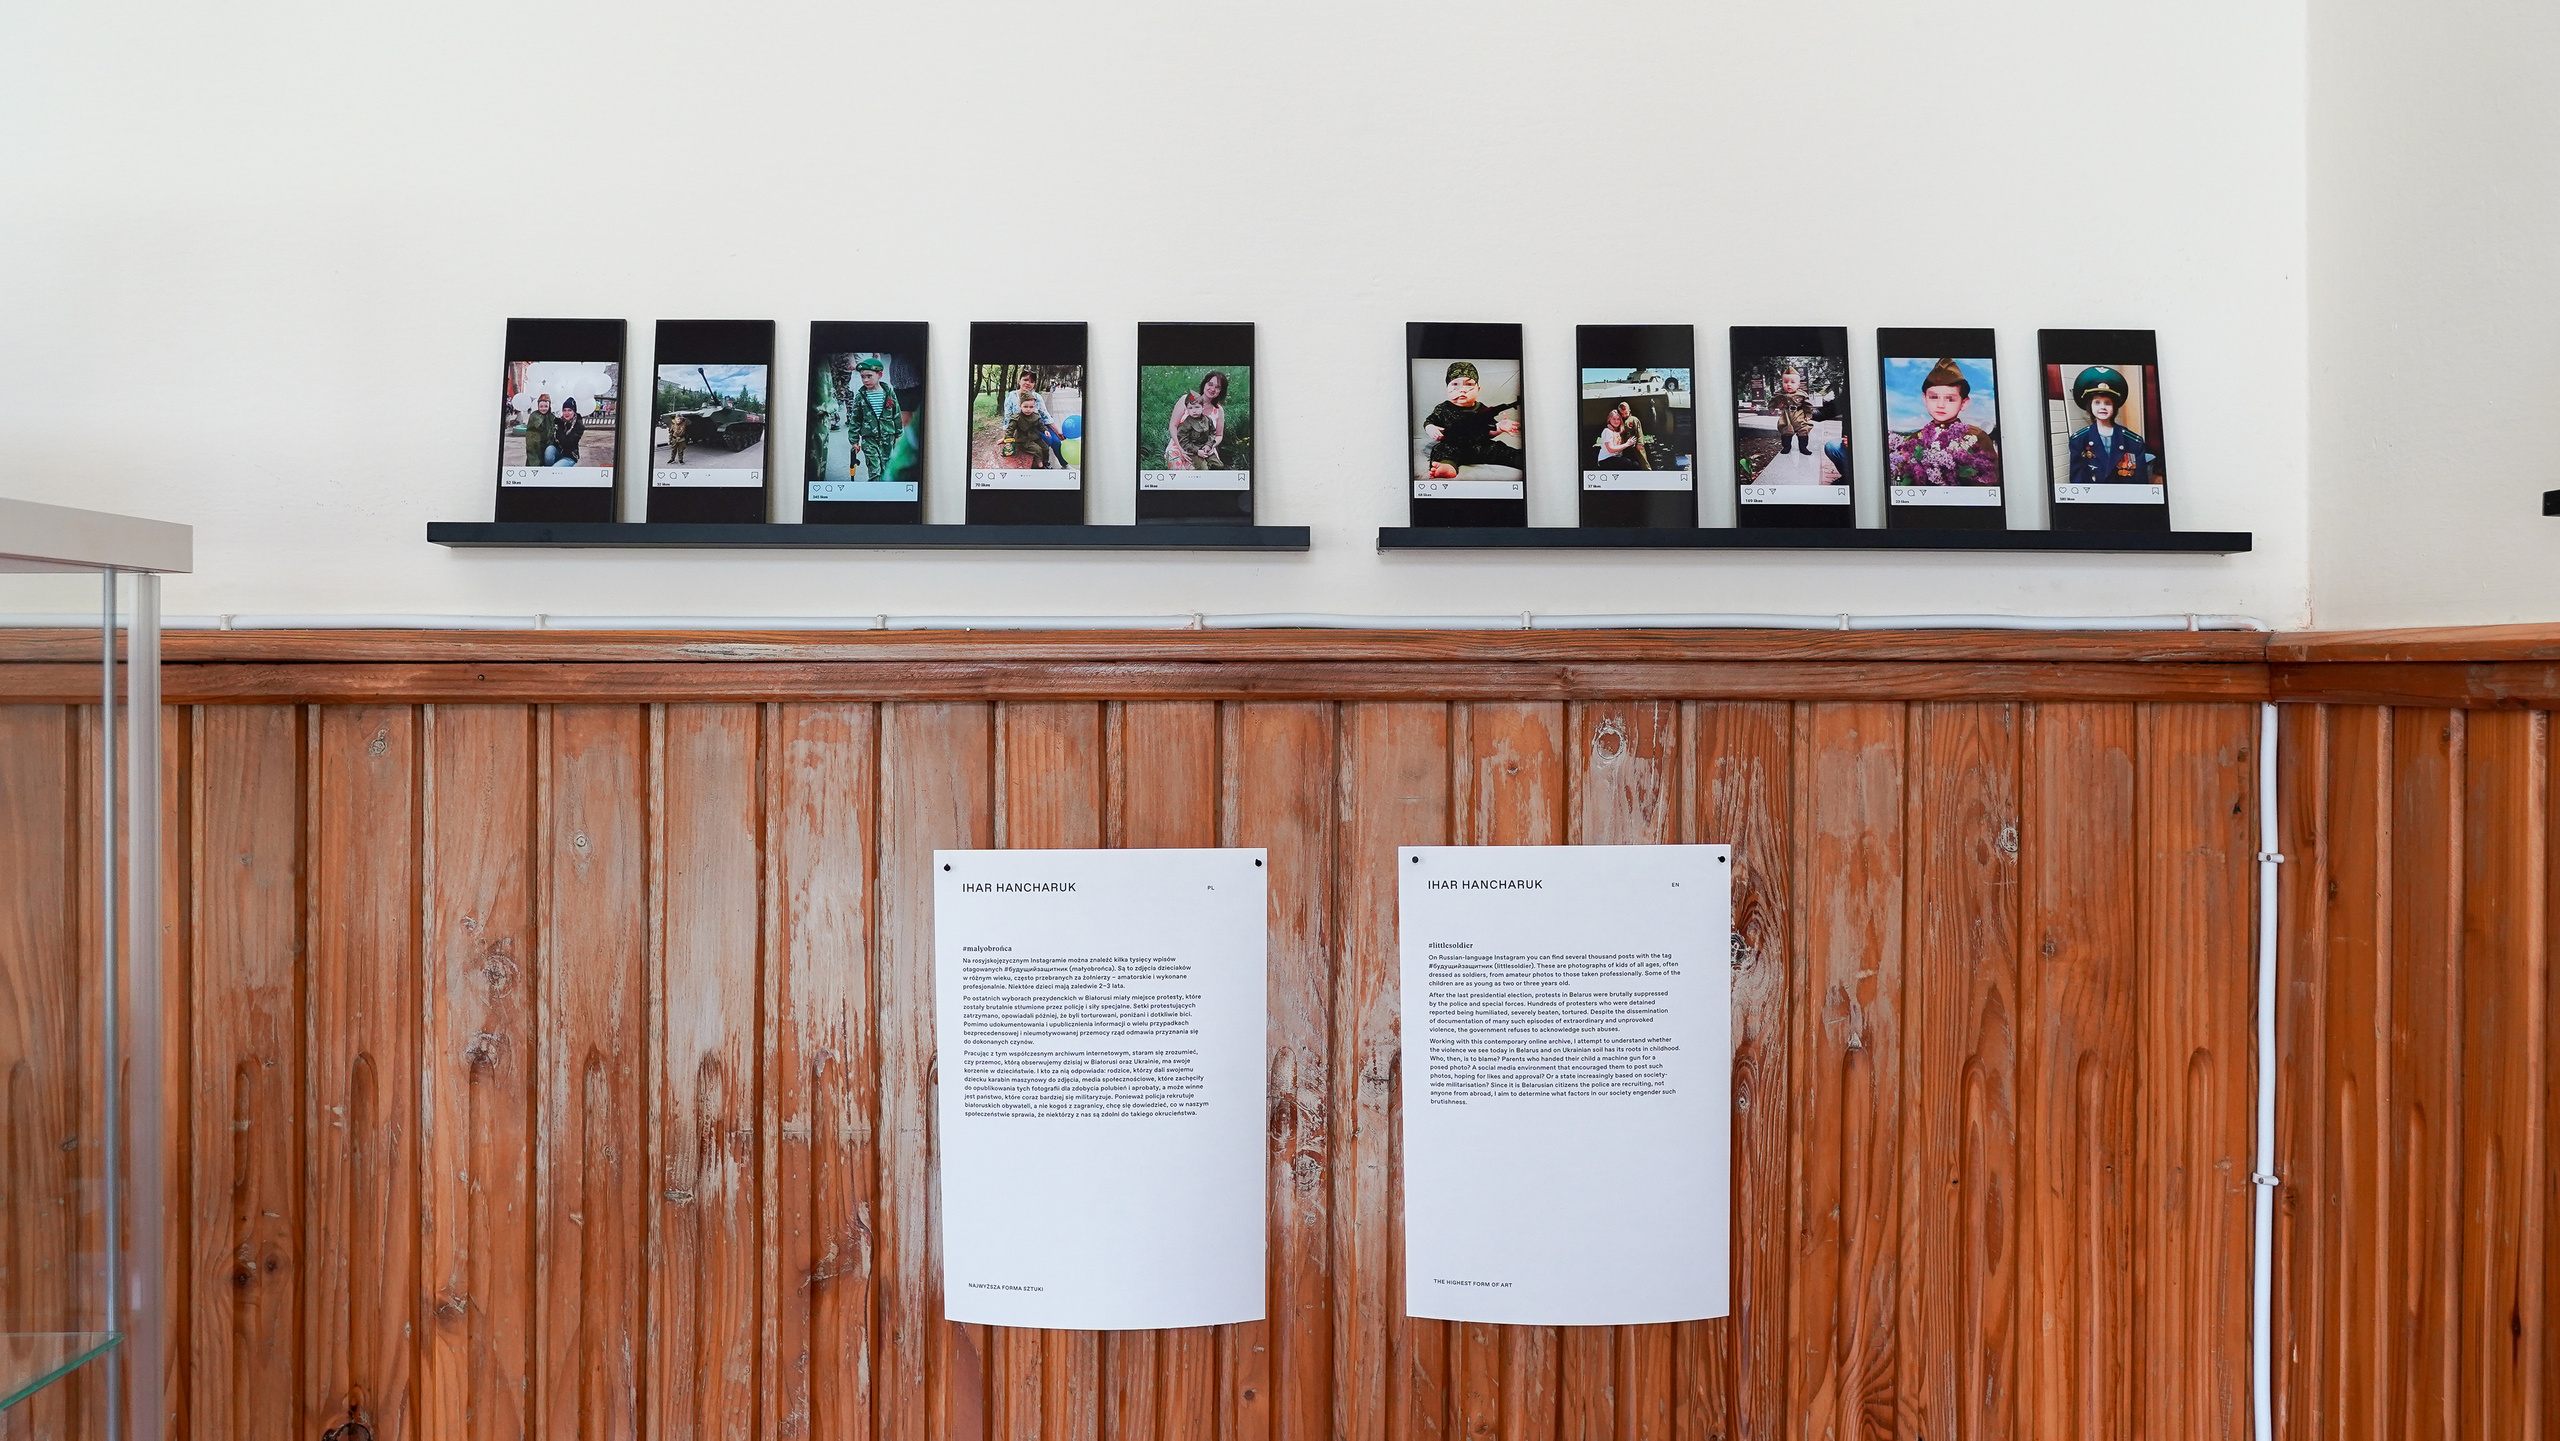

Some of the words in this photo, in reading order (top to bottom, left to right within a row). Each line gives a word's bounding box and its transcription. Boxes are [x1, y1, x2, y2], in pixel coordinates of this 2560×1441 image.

[962, 883, 992, 892] IHAR
[996, 882, 1076, 893] HANCHARUK
[1428, 880, 1458, 890] IHAR
[1462, 879, 1542, 890] HANCHARUK
[1030, 956, 1067, 965] Instagramie
[1129, 956, 1152, 964] tysięcy
[1152, 956, 1176, 964] wpisów
[1438, 953, 1493, 962] Russian-language
[1494, 953, 1526, 961] Instagram
[1617, 952, 1635, 961] posts
[1661, 952, 1672, 960] tag
[962, 966, 1003, 974] otagowanych
[1117, 965, 1126, 973] Są
[1134, 964, 1157, 973] zdjęcia
[1567, 962, 1607, 970] photographs
[969, 974, 992, 982] różnym
[993, 974, 1013, 982] wieku,
[1013, 974, 1034, 982] często
[1035, 974, 1074, 982] przebranych
[1156, 973, 1187, 981] wykonane
[1532, 971, 1554, 979] photos
[1054, 983, 1070, 991] mają
[1001, 995, 1032, 1003] wyborach
[1032, 994, 1077, 1003] prezydenckich
[1113, 994, 1131, 1002] miały
[1131, 994, 1156, 1002] miejsce
[1469, 991, 1507, 999] presidential
[1534, 991, 1561, 999] protests
[1609, 990, 1633, 999] brutally
[1633, 990, 1669, 998] suppressed
[1468, 1026, 1507, 1034] government
[1539, 1026, 1580, 1034] acknowledge
[972, 1038, 1009, 1046] dokonanych
[963, 1050, 989, 1058] Pracując
[995, 1050, 1008, 1058] tym
[1155, 1049, 1164, 1057] się
